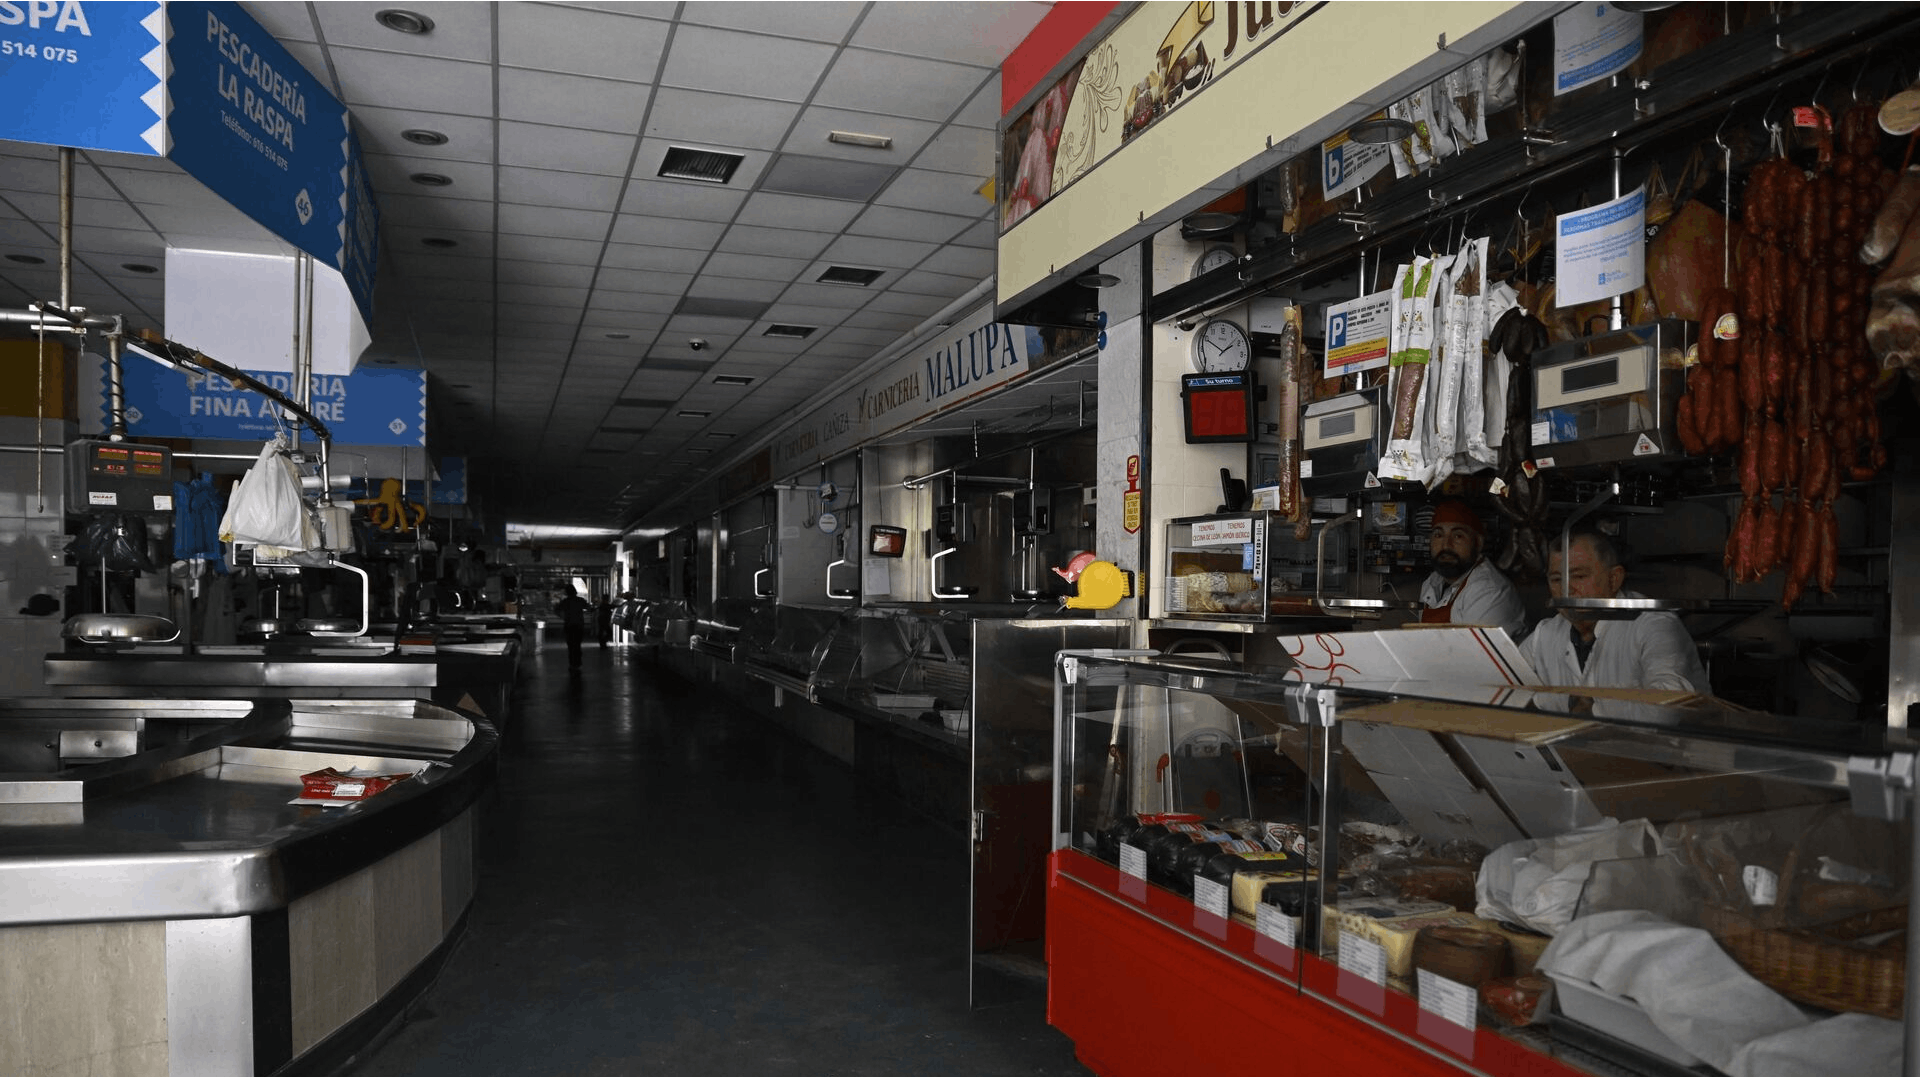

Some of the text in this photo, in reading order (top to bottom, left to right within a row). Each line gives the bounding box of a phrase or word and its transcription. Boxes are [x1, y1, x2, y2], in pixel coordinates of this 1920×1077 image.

[2, 40, 79, 64] 514 075
[206, 9, 306, 125] PESCADERÍA
[218, 63, 294, 152] LA RASPA
[1331, 316, 1344, 346] P
[867, 371, 920, 419] CARNICERIA
[925, 322, 1018, 402] MALUPA
[190, 396, 252, 417] FINA
[1198, 524, 1215, 532] TENEMOS
[1227, 522, 1245, 530] TENEMOS
